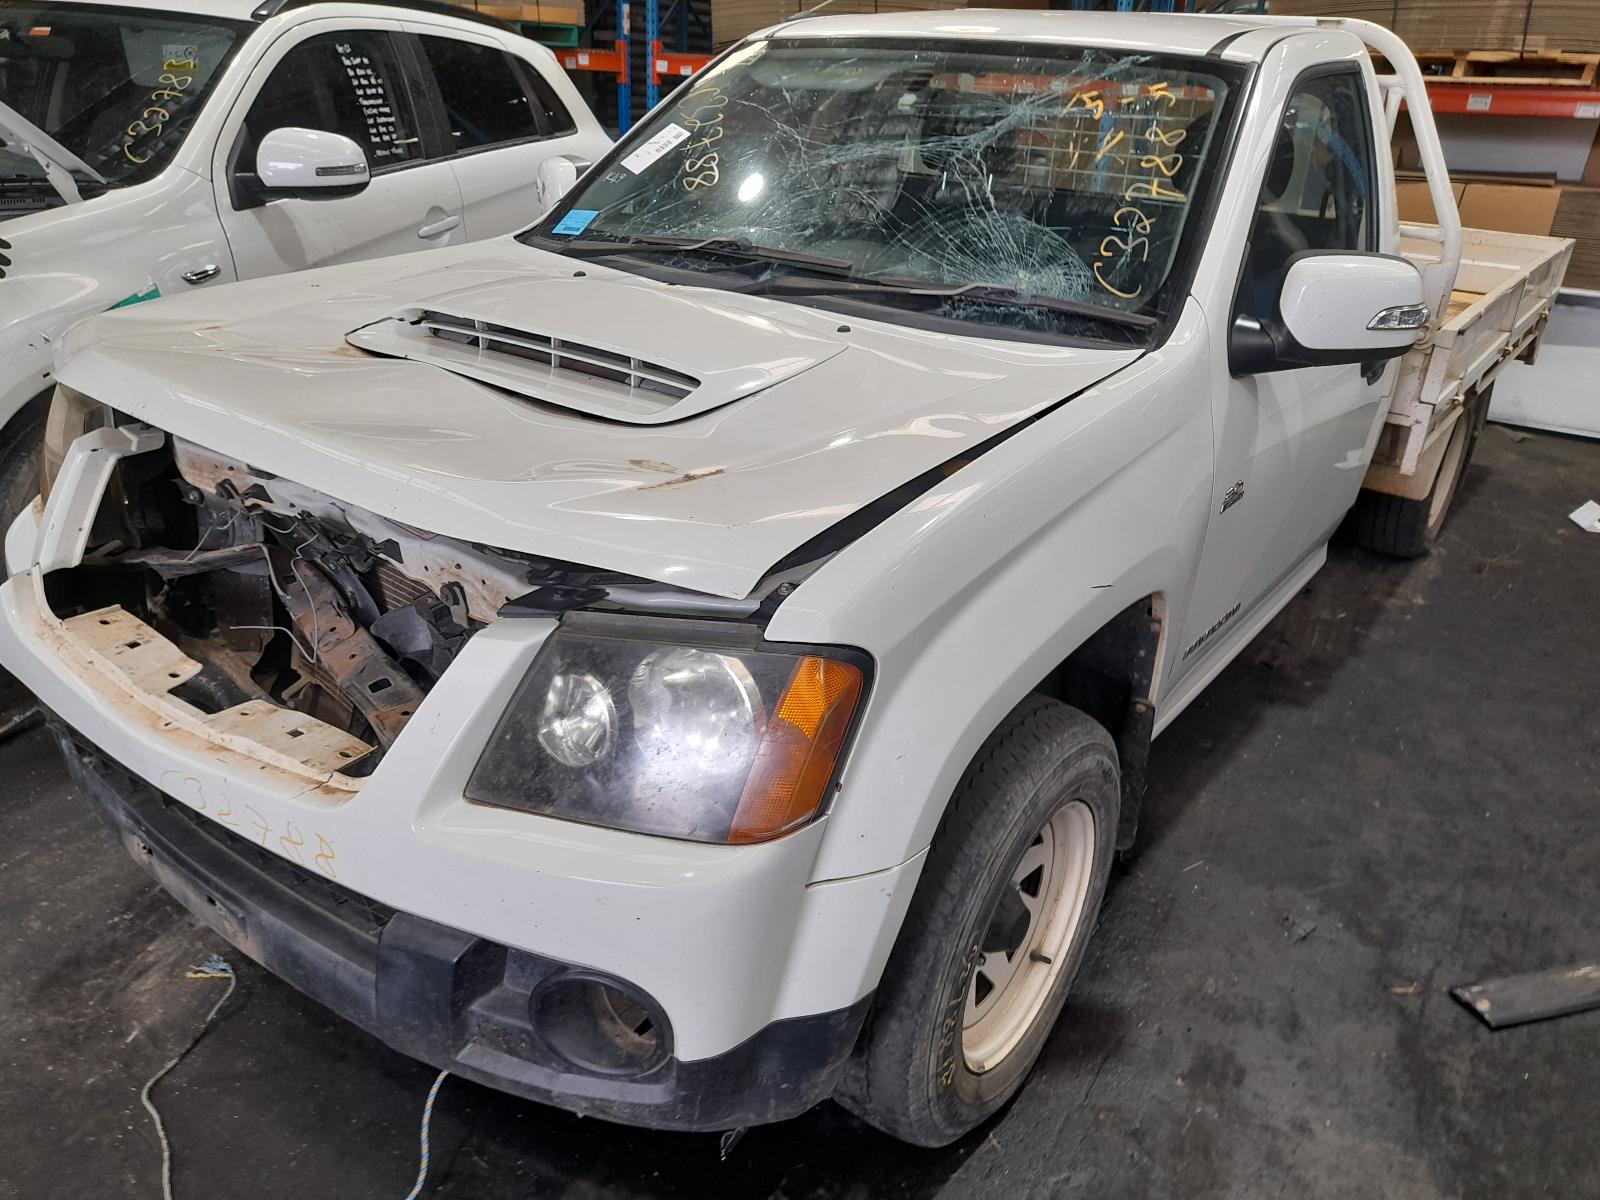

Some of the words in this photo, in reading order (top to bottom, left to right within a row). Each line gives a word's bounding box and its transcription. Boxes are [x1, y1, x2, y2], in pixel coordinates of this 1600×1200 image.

[676, 87, 729, 191] C32788
[1093, 126, 1187, 299] C32788
[159, 770, 337, 880] C32788
